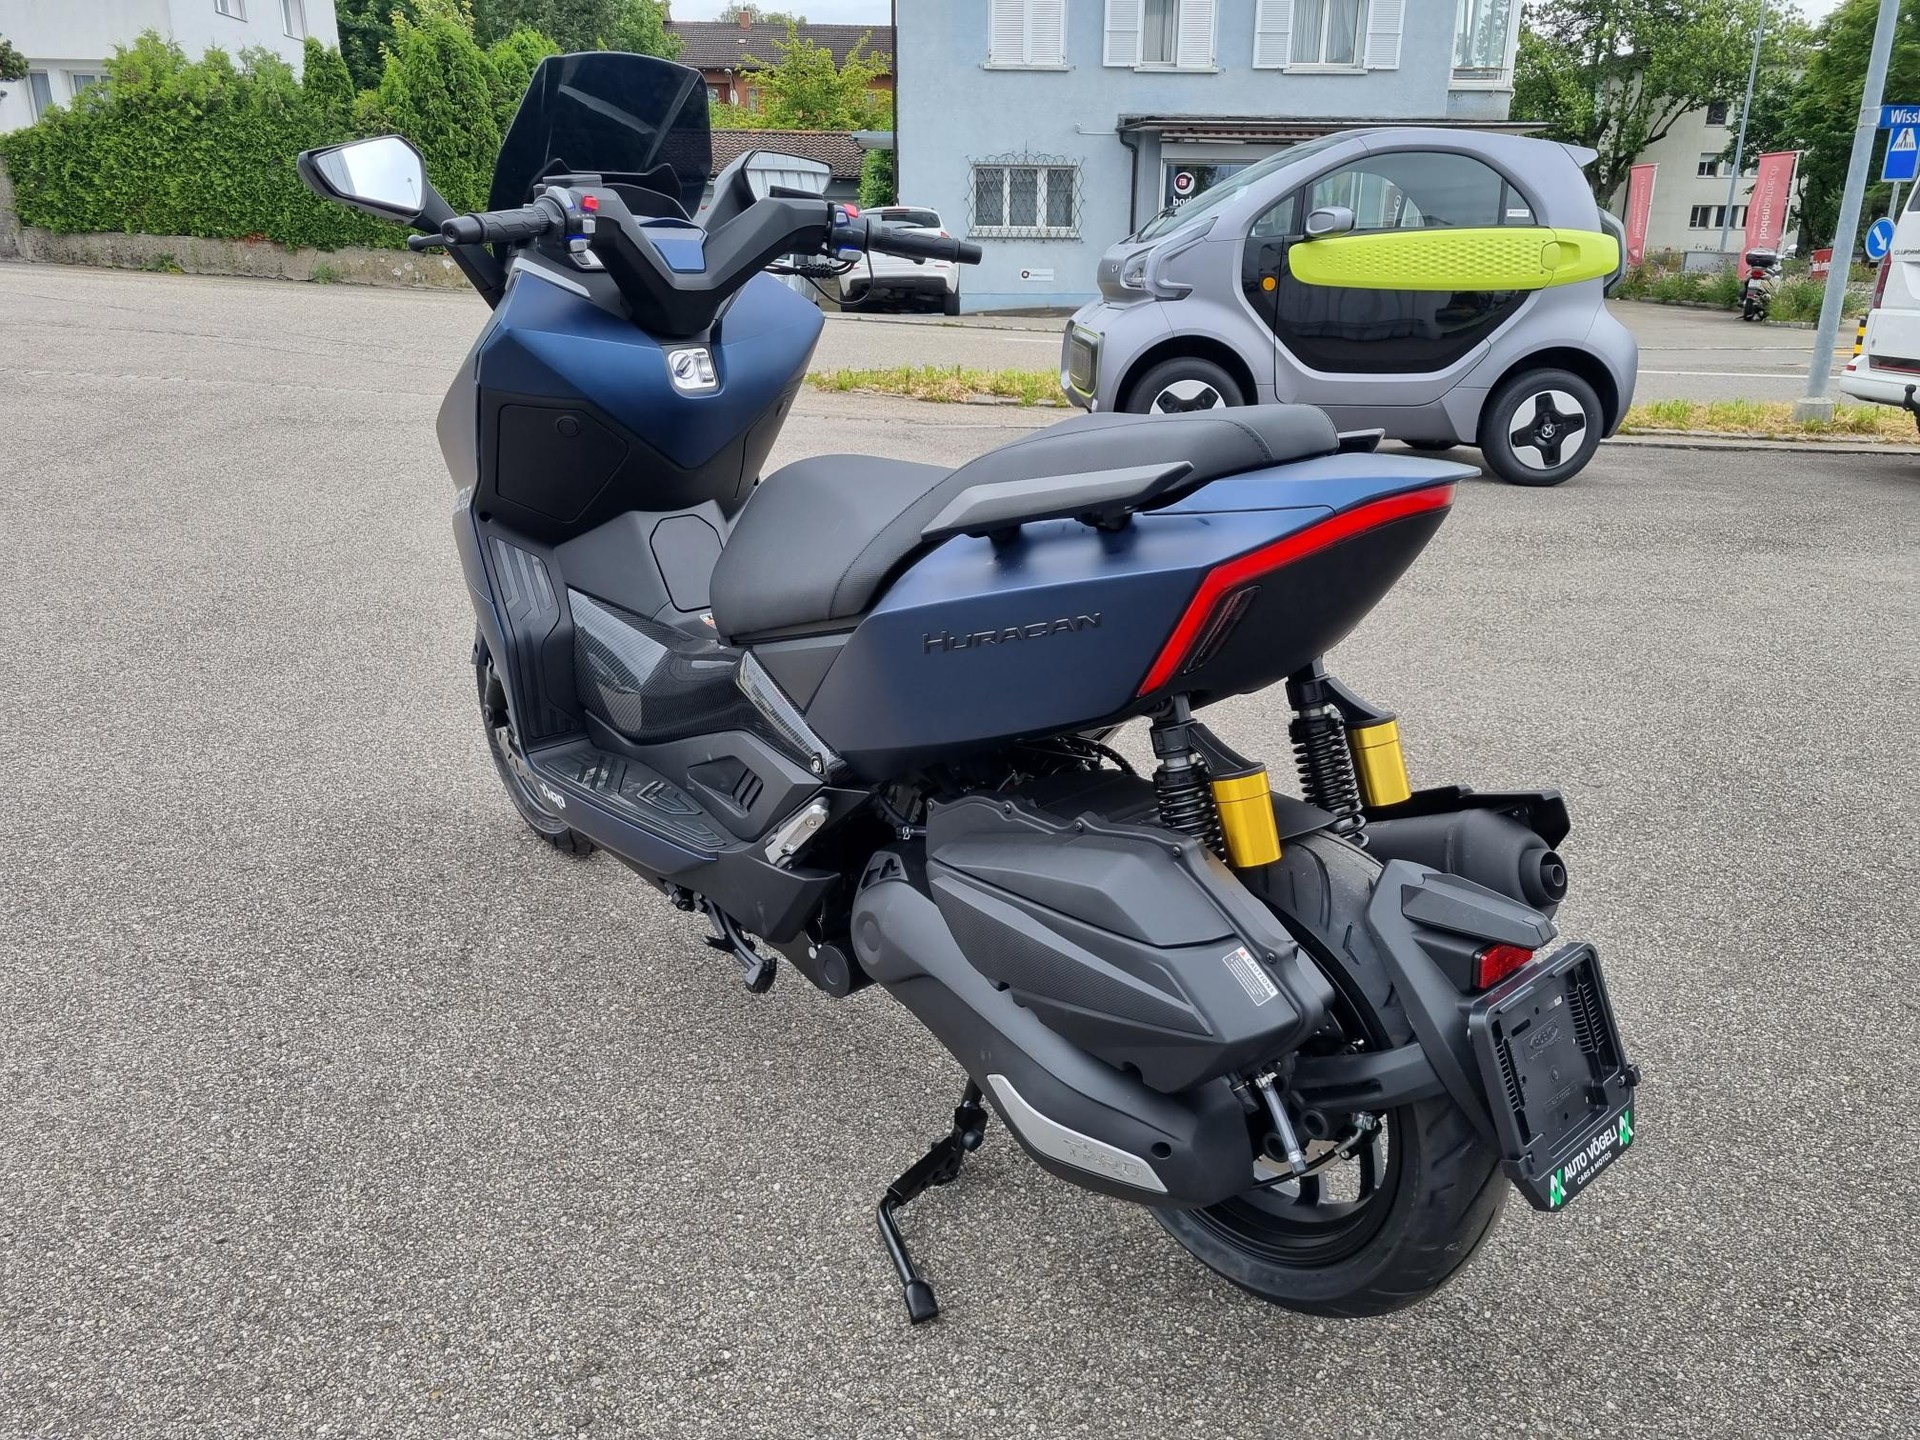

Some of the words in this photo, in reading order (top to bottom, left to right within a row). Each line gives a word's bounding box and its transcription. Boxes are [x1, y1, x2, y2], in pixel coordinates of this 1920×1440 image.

[1246, 957, 1275, 994] CAUTIONS
[1564, 1151, 1588, 1182] AUTO
[1586, 1124, 1618, 1160] VÖGELI
[1577, 1168, 1591, 1185] CARS
[1594, 1150, 1612, 1170] MOTOS
